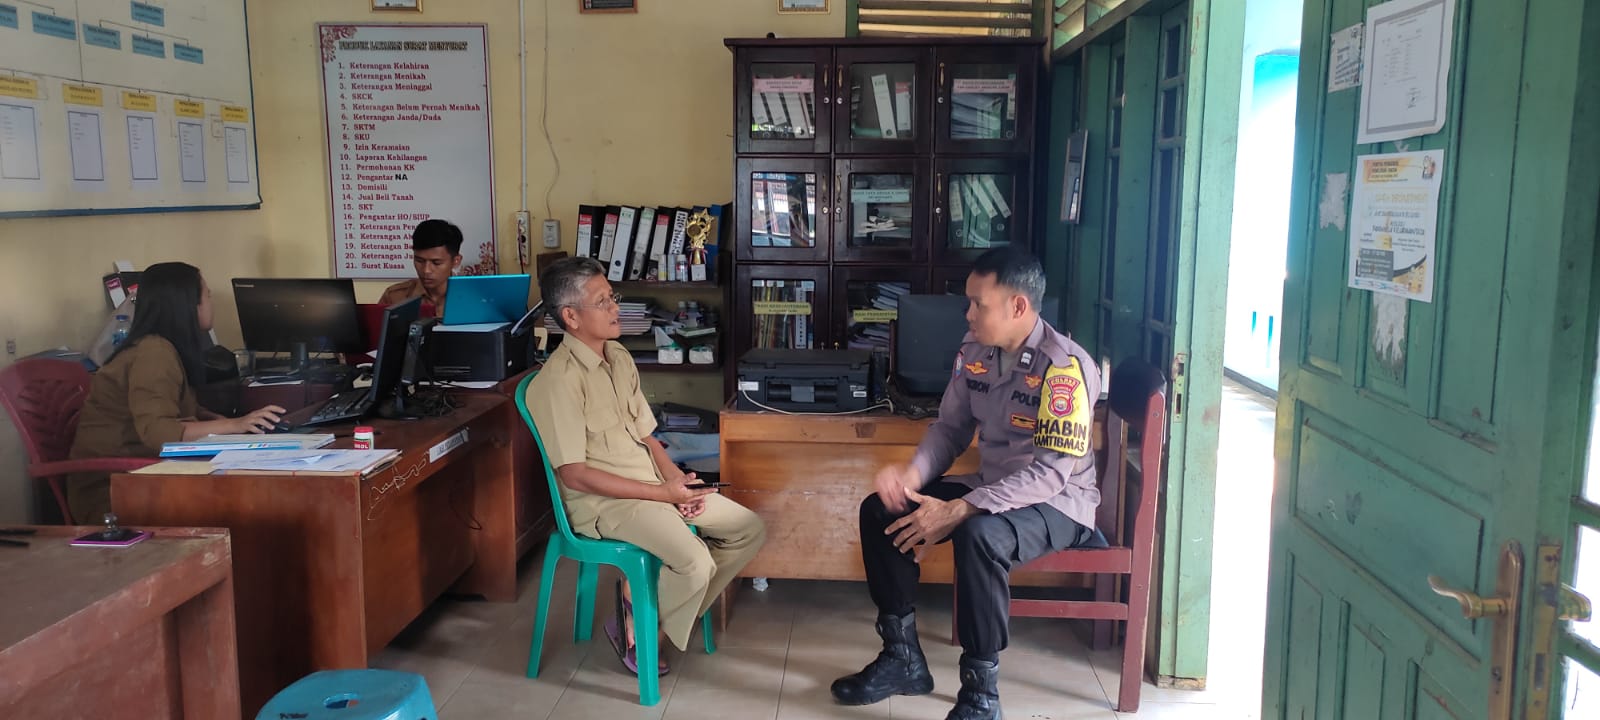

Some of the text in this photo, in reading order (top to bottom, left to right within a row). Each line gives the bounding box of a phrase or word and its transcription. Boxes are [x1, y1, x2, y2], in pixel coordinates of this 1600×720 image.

[350, 63, 391, 71] Keterangan
[351, 73, 392, 81] Keterangan
[352, 83, 393, 91] Keterangan
[395, 83, 432, 91] Meninggal
[354, 114, 394, 122] Keterangan
[397, 114, 441, 122] Janda/Duda
[1011, 390, 1041, 407] POLR
